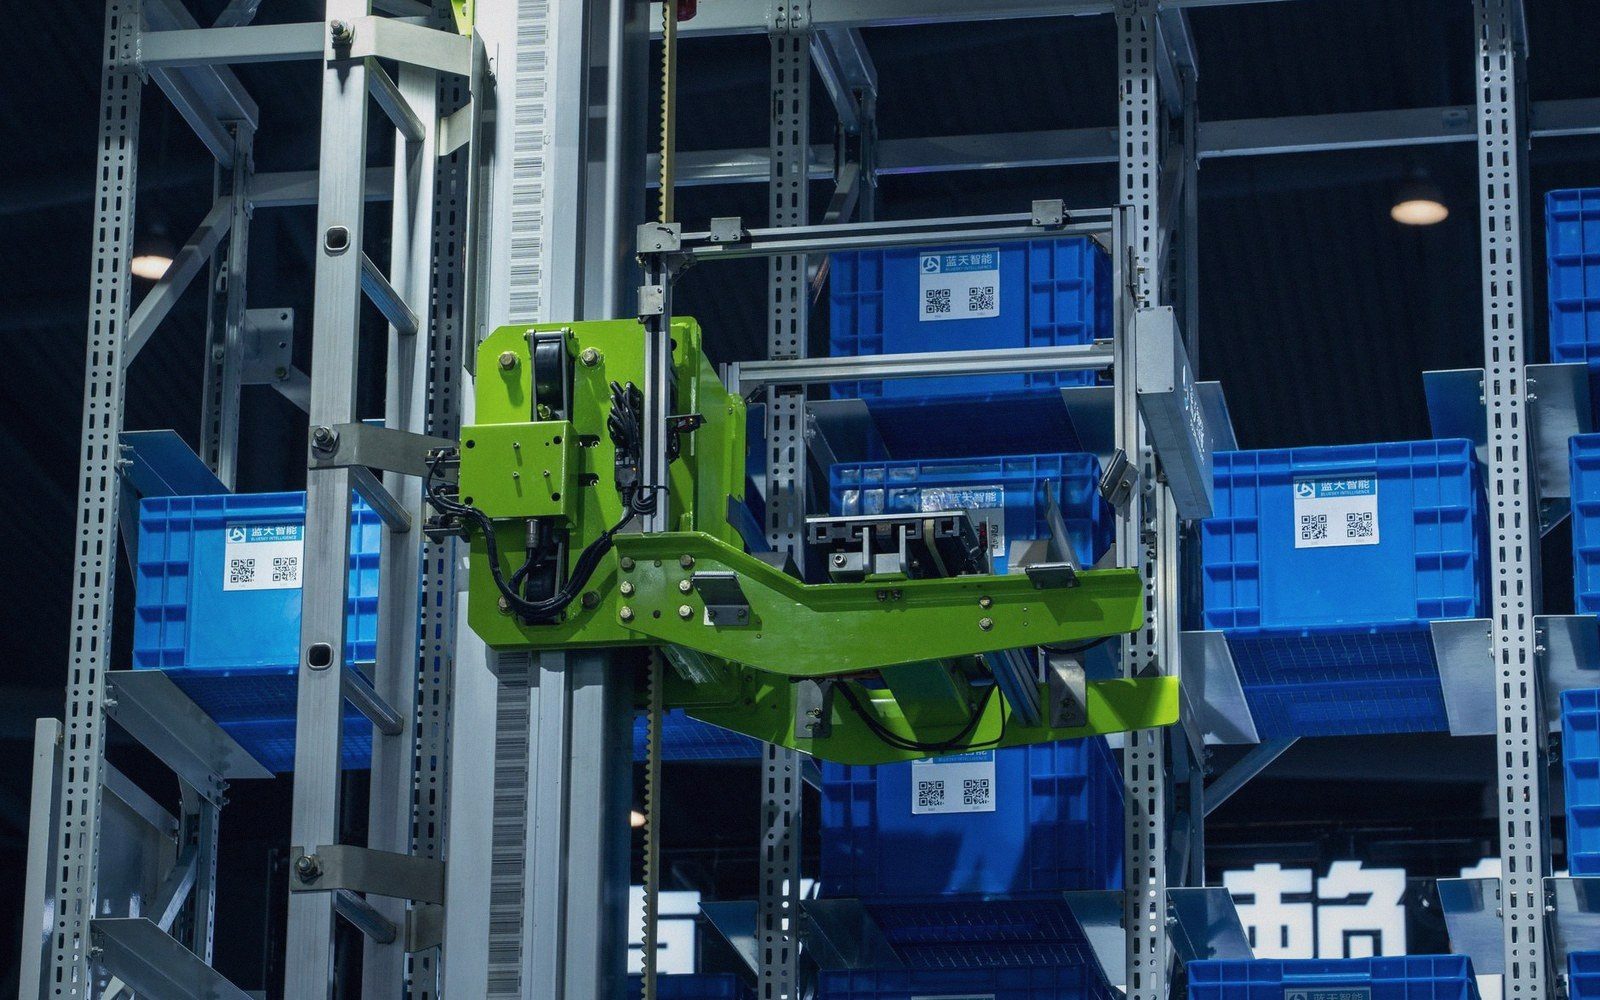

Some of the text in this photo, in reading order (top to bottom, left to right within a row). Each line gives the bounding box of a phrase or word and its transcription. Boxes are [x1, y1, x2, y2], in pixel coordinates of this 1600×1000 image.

[946, 253, 992, 267] 蓝天智能
[1321, 479, 1370, 491] 蓝天智能
[251, 525, 298, 537] 蓝天智能
